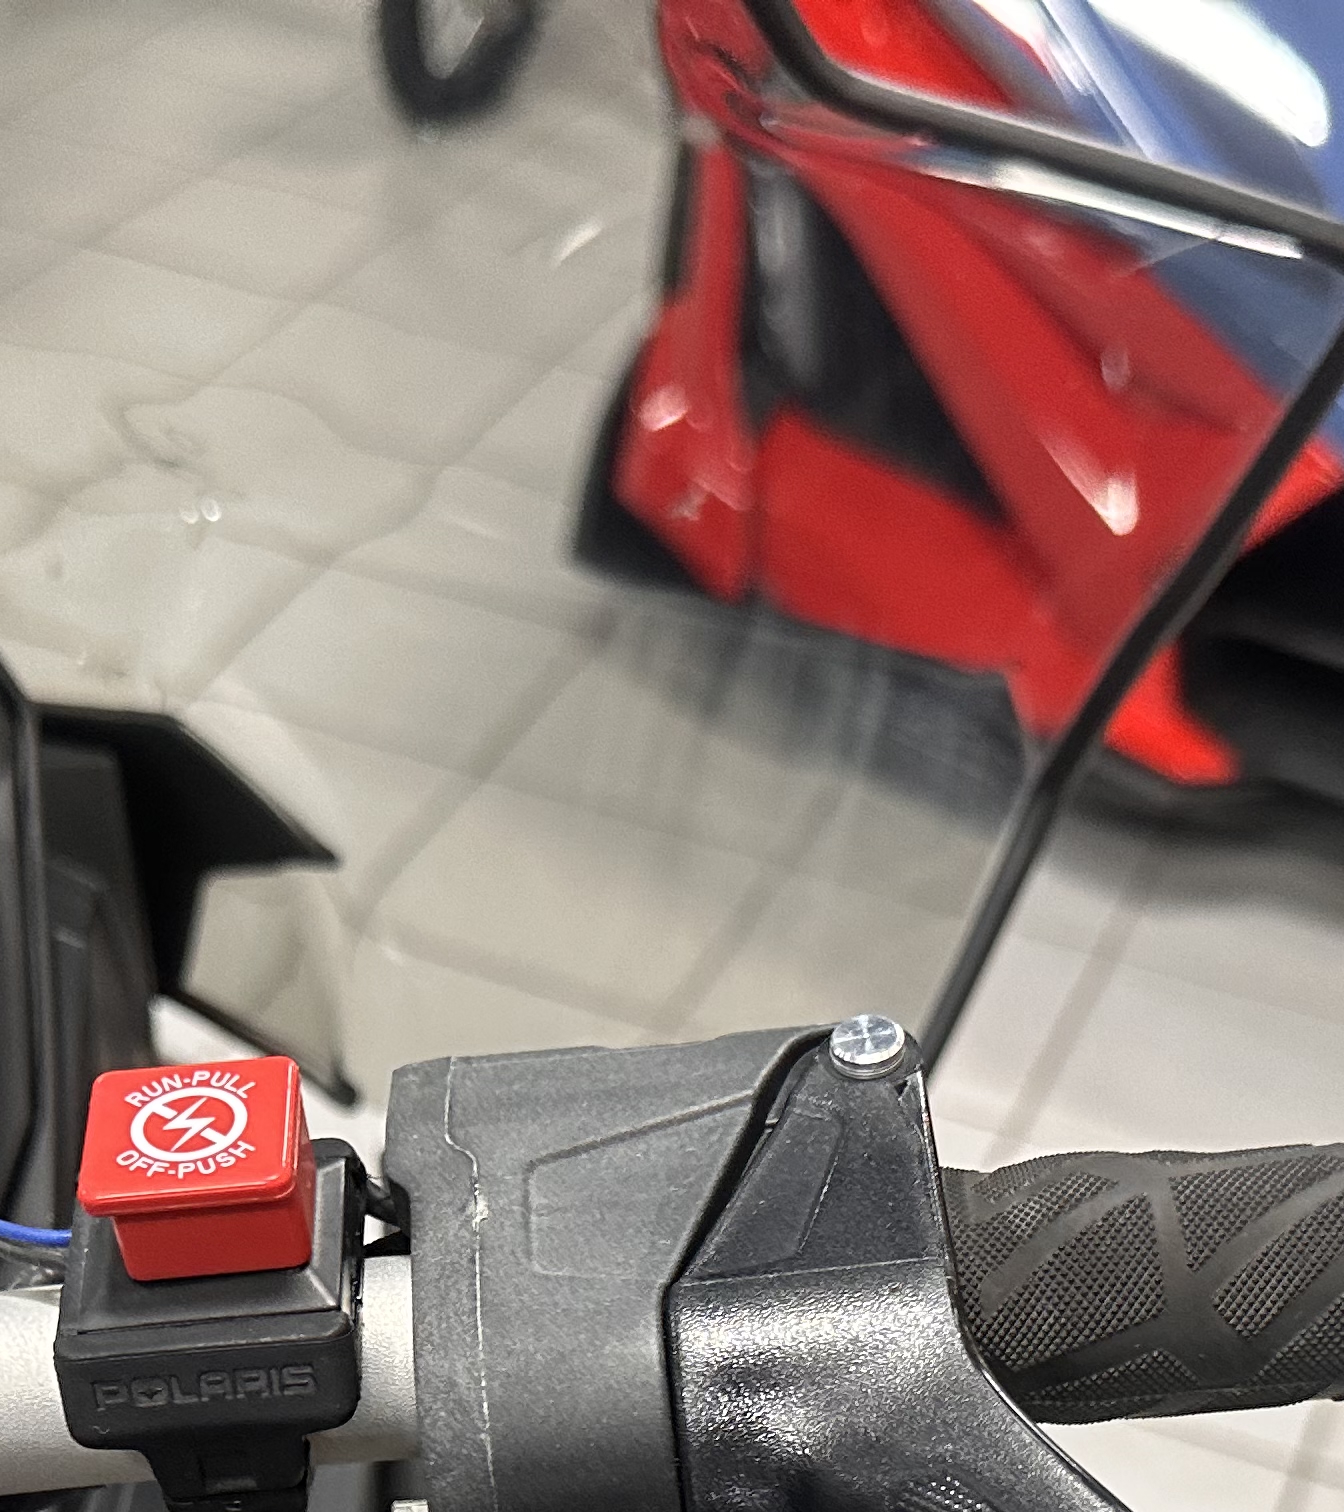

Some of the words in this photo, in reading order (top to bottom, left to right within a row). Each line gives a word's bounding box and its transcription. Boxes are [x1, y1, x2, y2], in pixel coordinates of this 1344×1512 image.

[124, 1070, 256, 1107] RUN-PULL
[116, 1140, 256, 1179] OFF-PUSH
[92, 1363, 318, 1411] POLARIS
